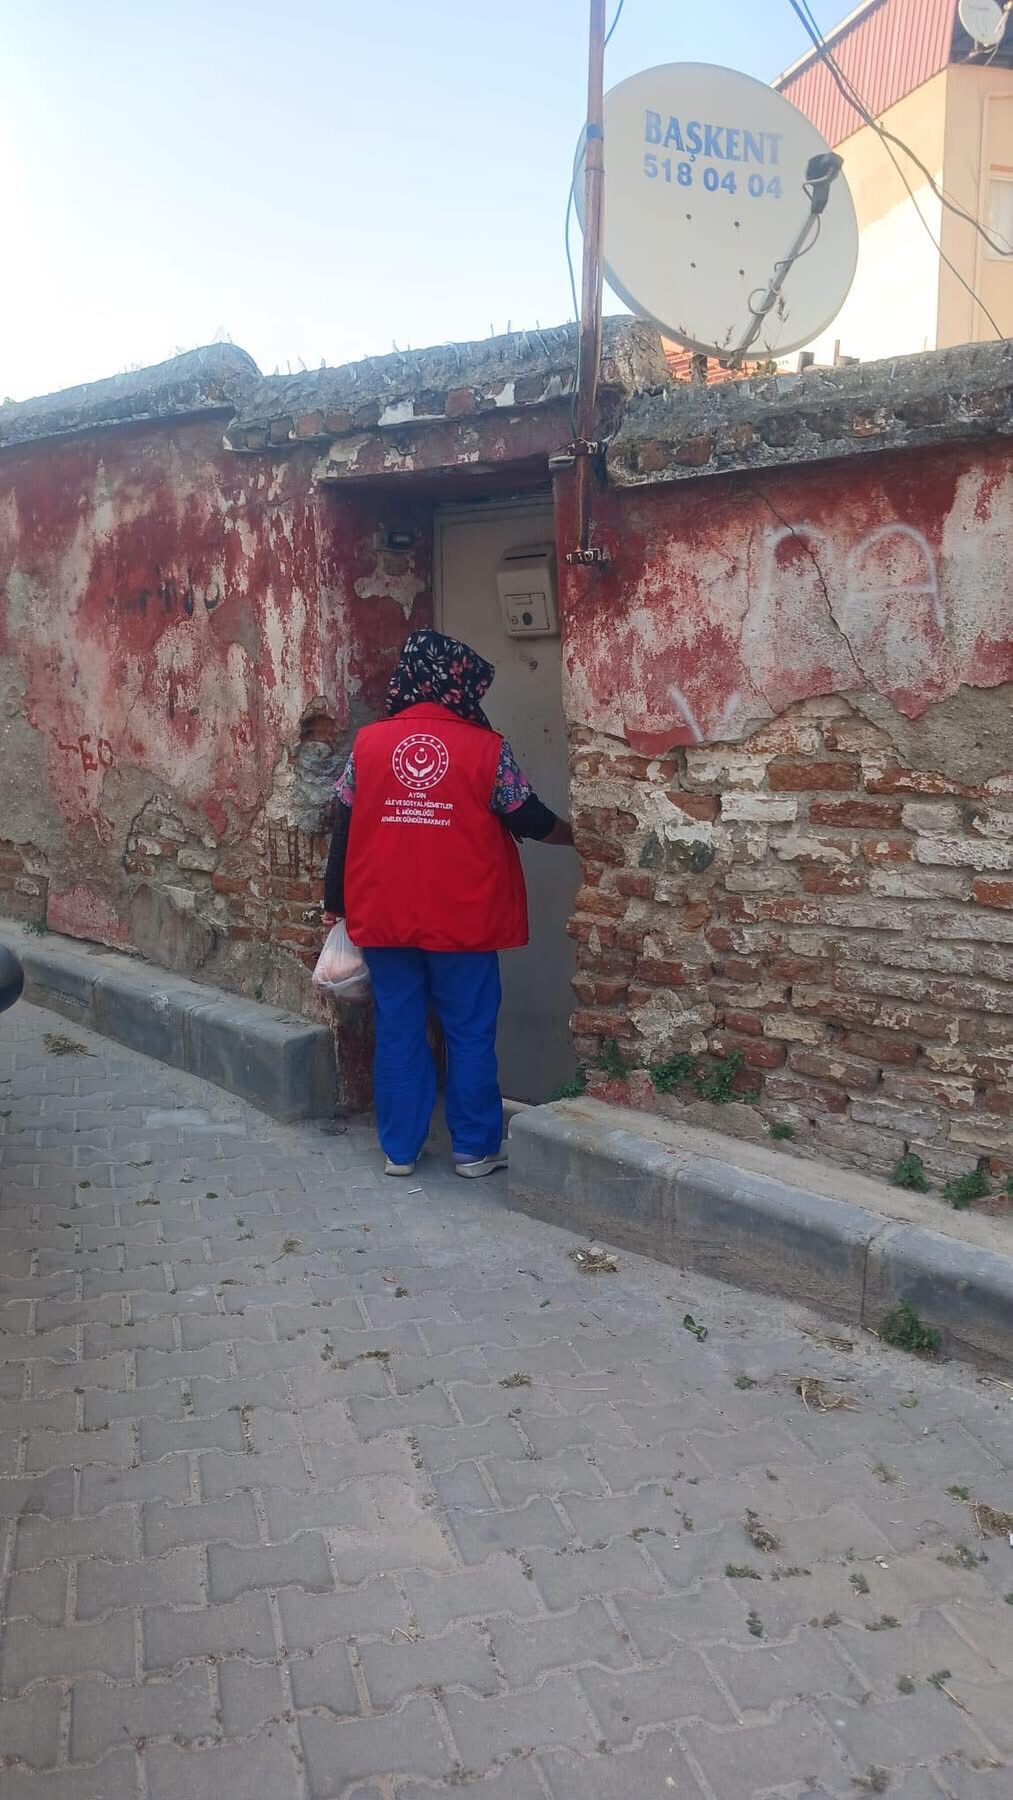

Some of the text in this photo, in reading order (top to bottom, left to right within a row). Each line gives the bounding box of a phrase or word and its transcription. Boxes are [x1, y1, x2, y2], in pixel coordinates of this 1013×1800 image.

[645, 109, 784, 165] BAŞKENT
[644, 153, 784, 199] 518 04 04
[395, 807, 434, 817] İL MÜDÜRLÜĞÜ
[402, 800, 424, 808] SOSYAL
[424, 802, 453, 810] HİZMETLER
